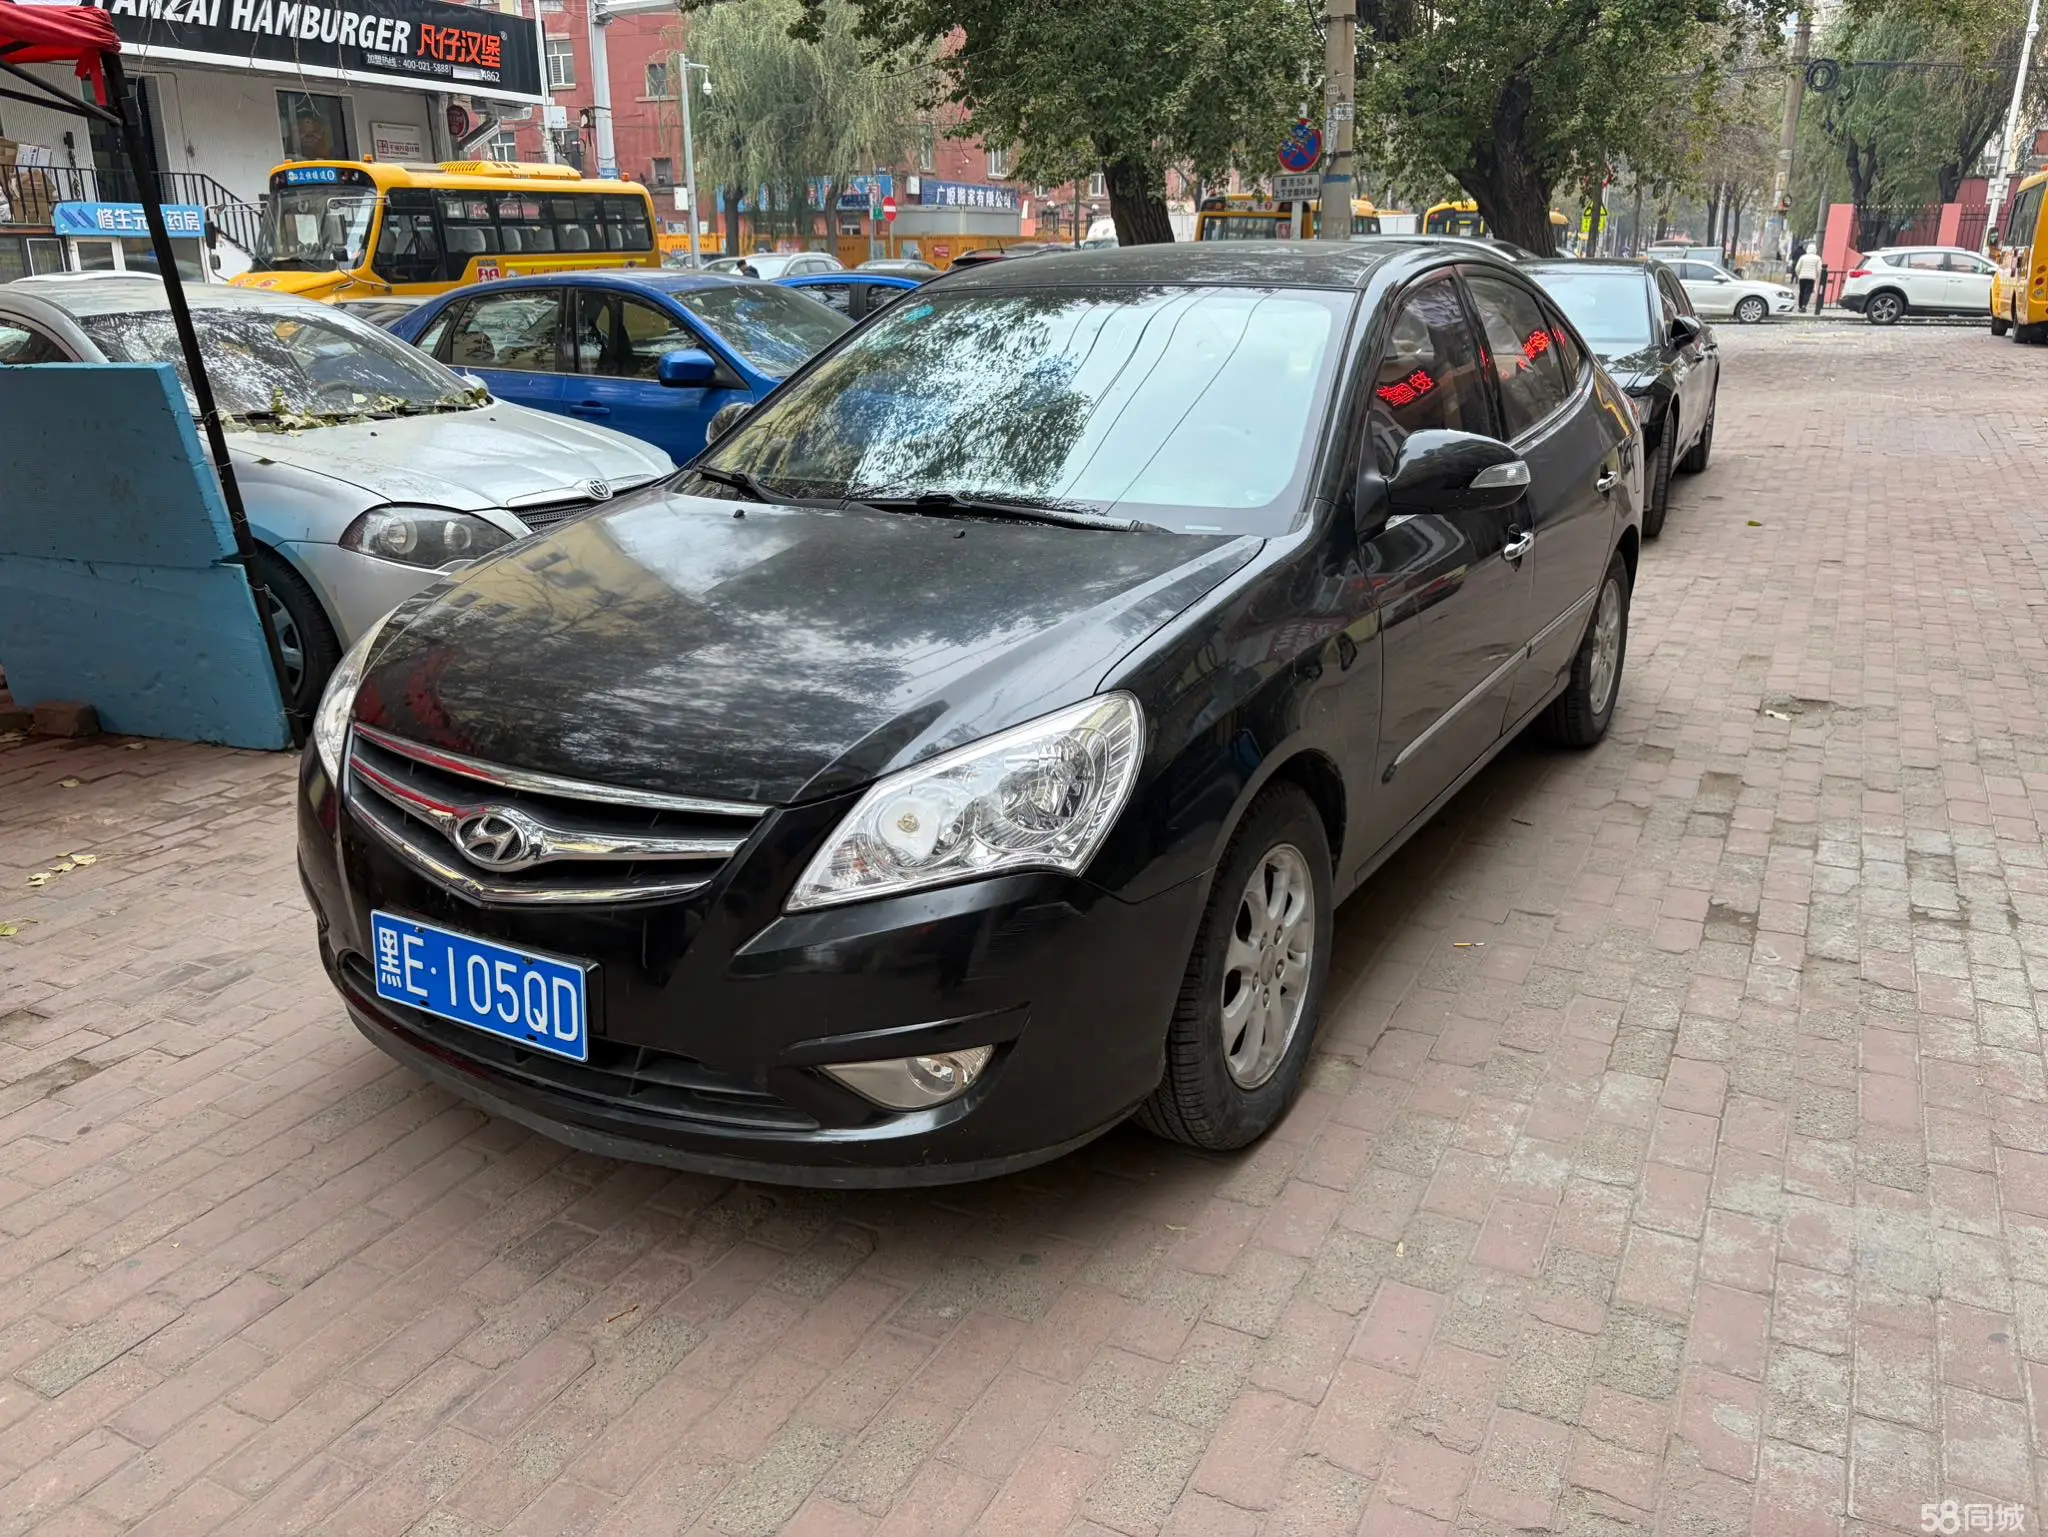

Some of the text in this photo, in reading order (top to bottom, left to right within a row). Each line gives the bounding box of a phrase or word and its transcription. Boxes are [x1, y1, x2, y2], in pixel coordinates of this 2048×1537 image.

[94, 0, 411, 54] NZAI HAMBURGER
[417, 23, 501, 68] 凡仔汉堡
[96, 207, 201, 231] 修生元药房
